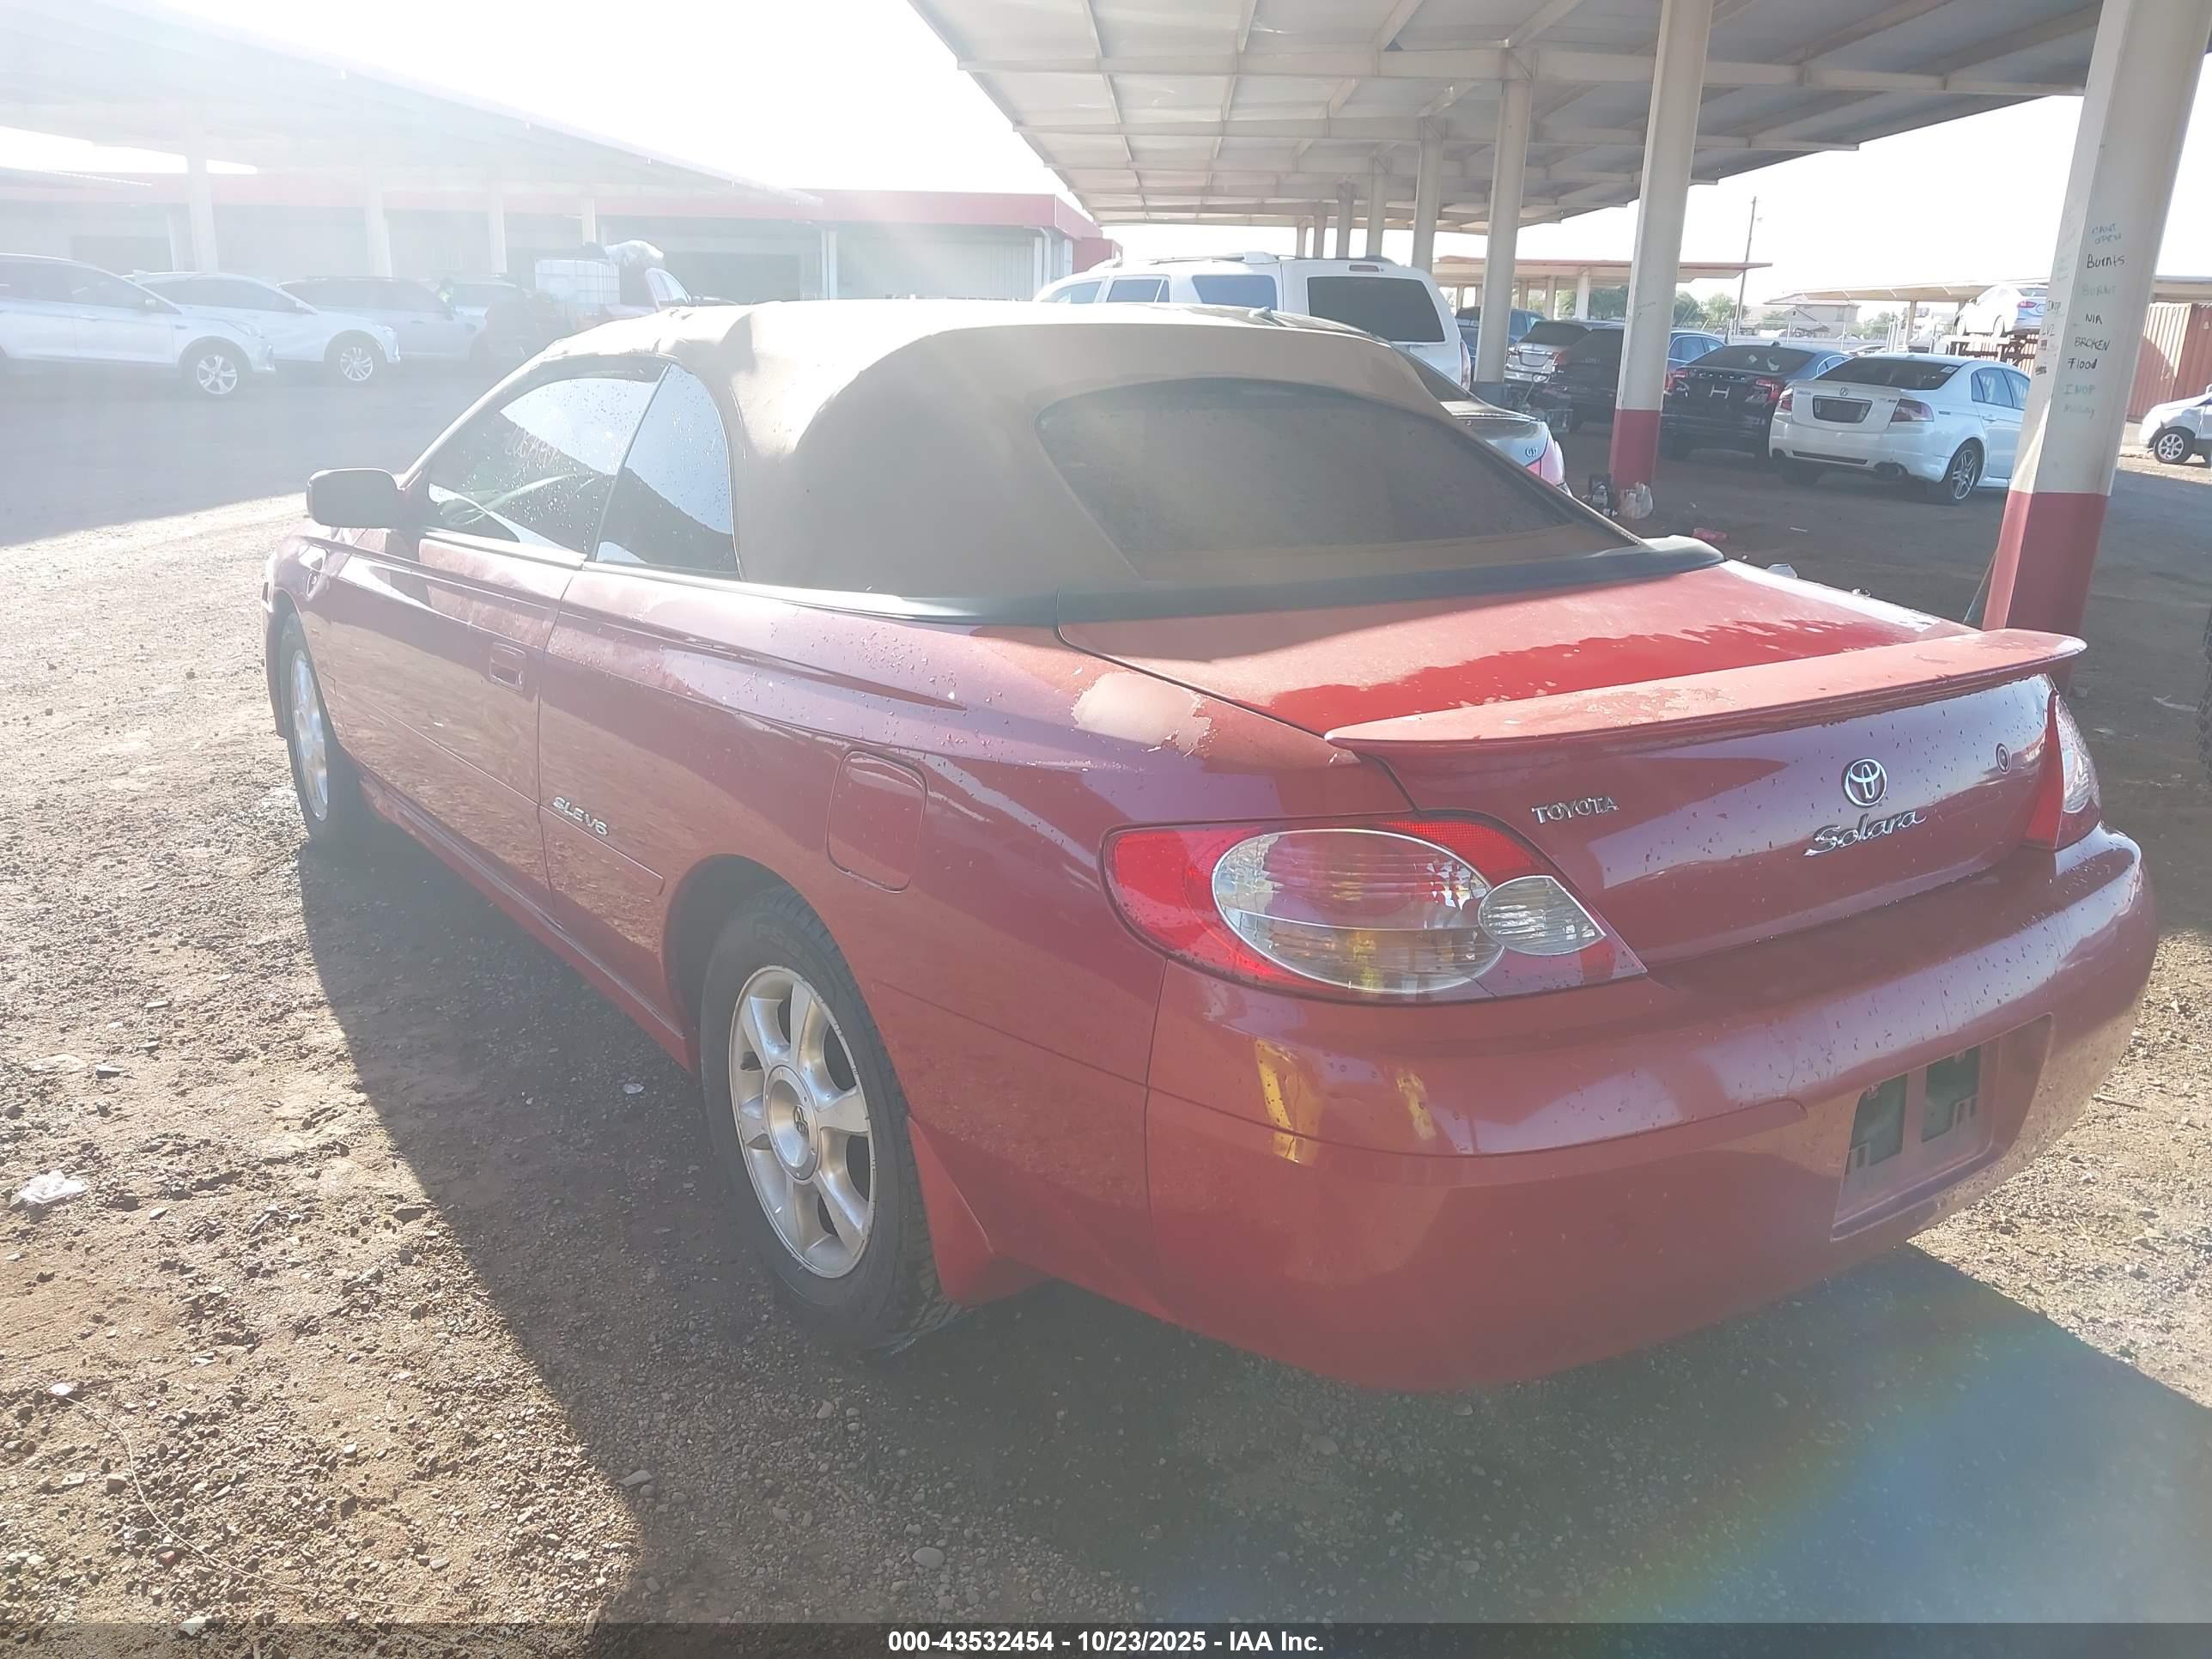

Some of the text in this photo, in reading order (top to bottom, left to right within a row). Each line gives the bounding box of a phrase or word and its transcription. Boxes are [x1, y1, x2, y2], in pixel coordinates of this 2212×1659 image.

[2075, 336, 2111, 351] BROKEN
[2068, 357, 2098, 369] Flood
[1531, 795, 1620, 824] TOYOTA
[1803, 809, 1927, 858] Solara
